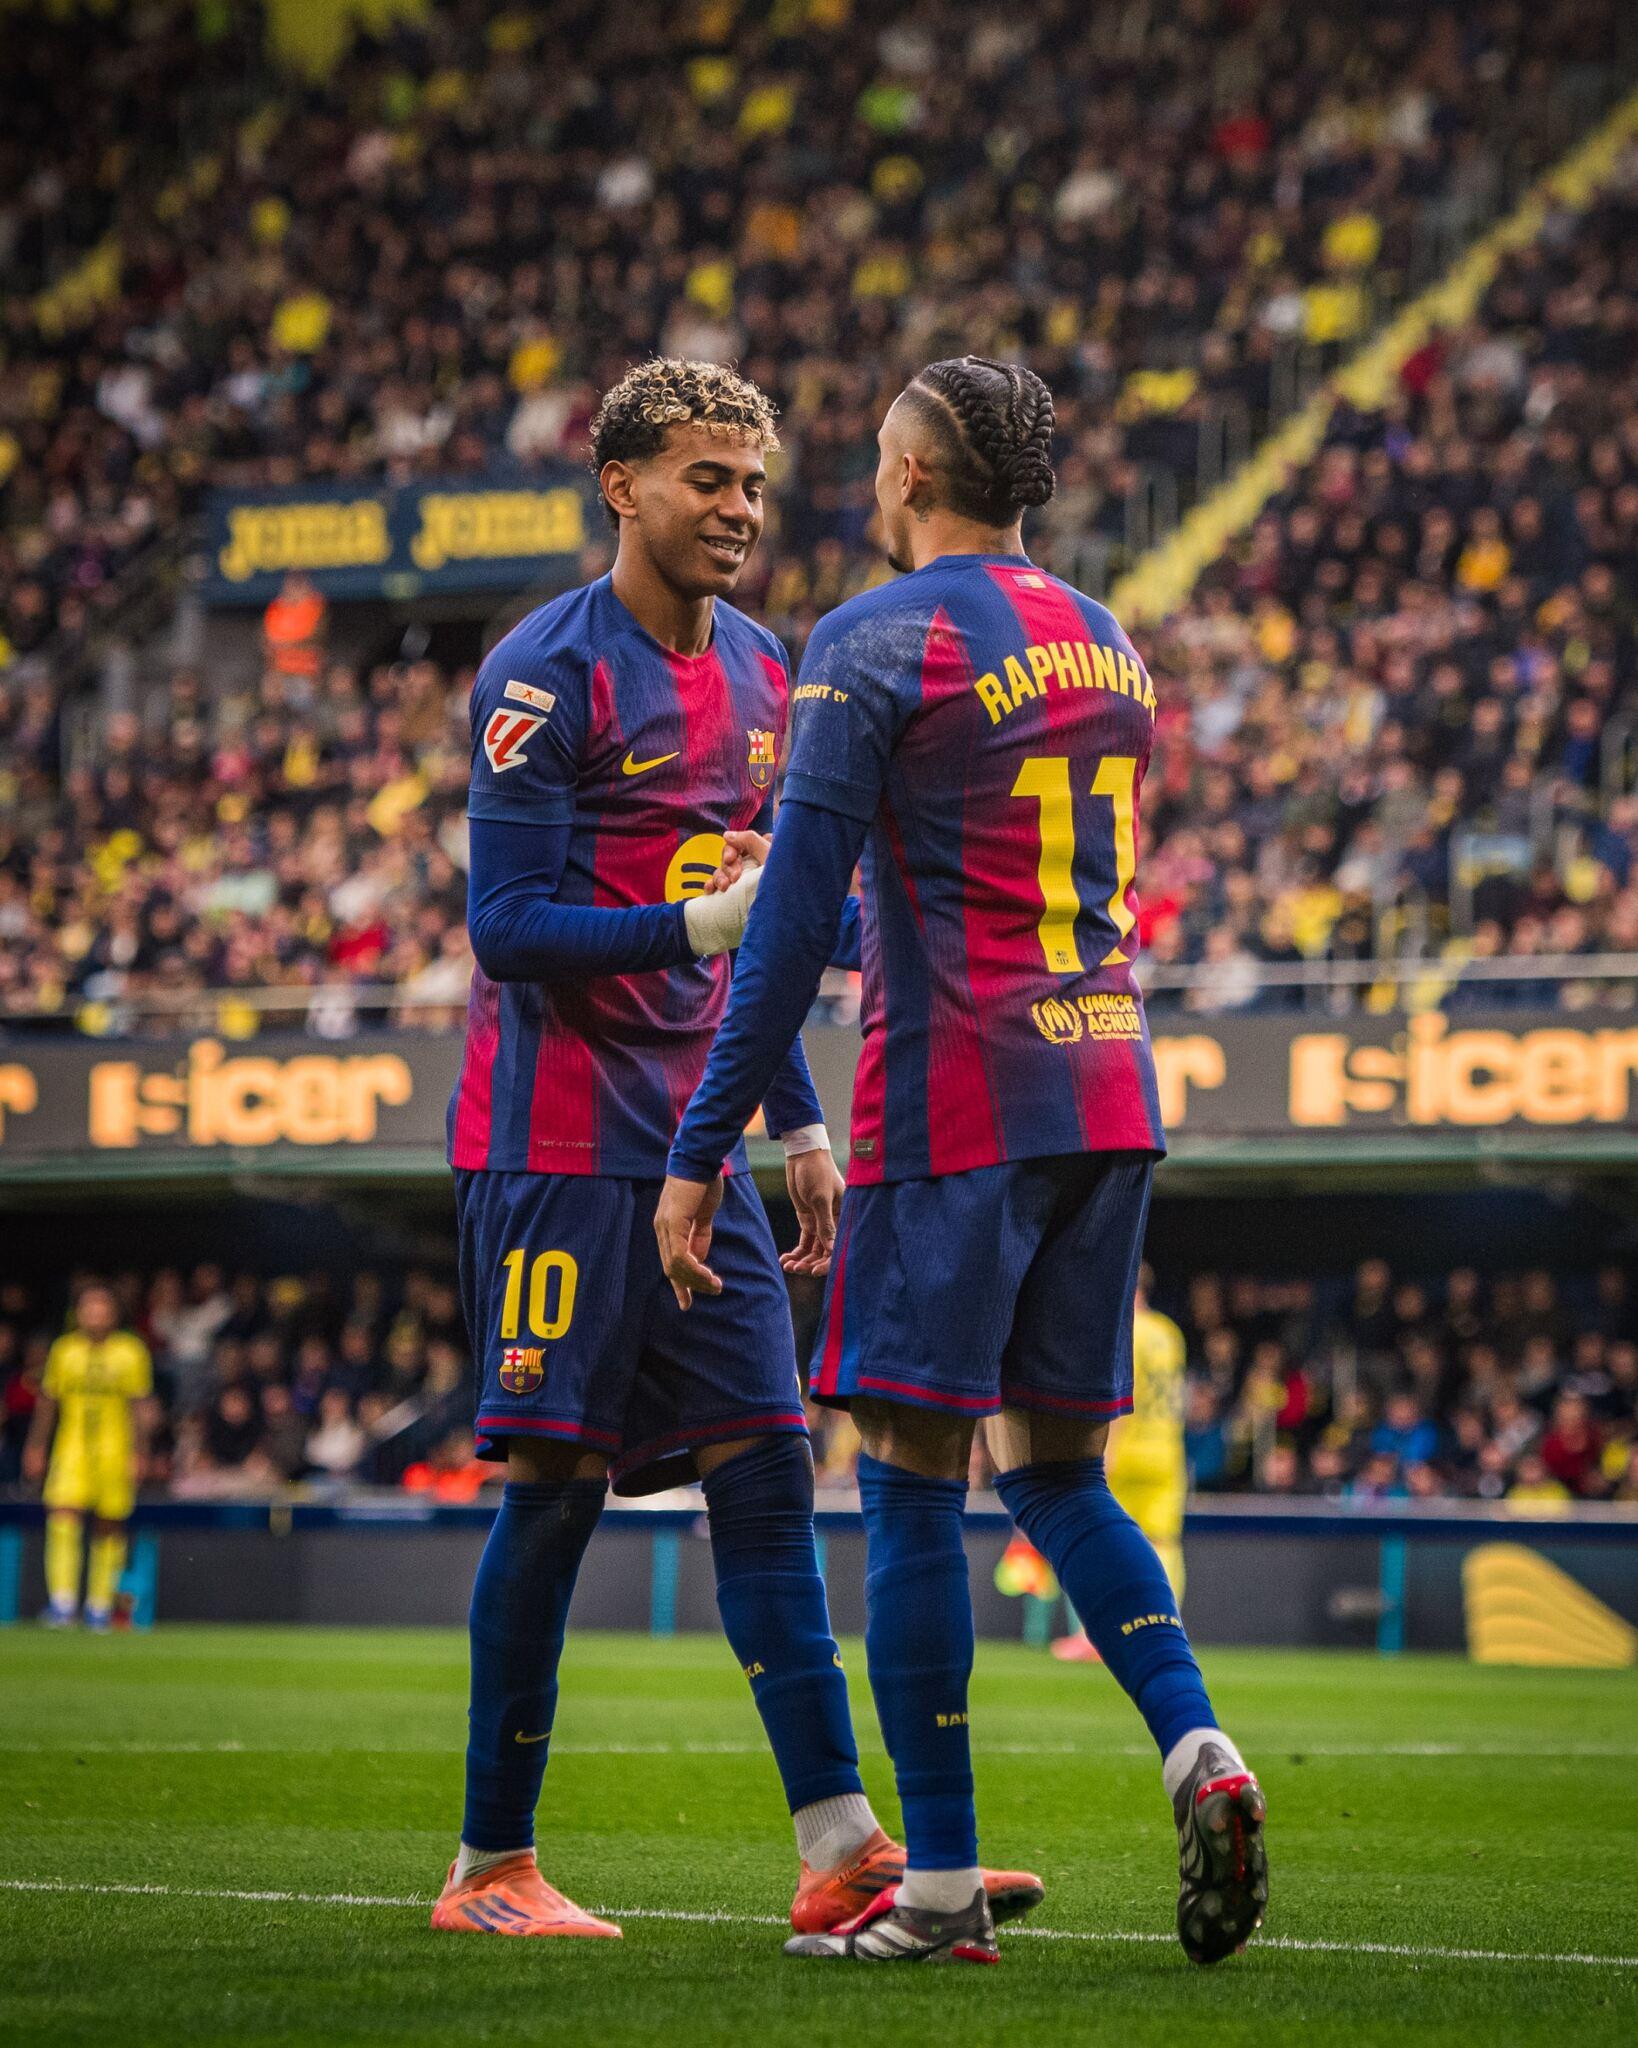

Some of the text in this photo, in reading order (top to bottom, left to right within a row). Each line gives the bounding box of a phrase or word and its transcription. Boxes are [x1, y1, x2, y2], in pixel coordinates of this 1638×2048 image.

[833, 690, 849, 703] tv
[1010, 757, 1138, 973] 11
[1077, 993, 1138, 1015] UNHCR
[1087, 1013, 1141, 1034] ACNUR
[501, 1248, 579, 1340] 10
